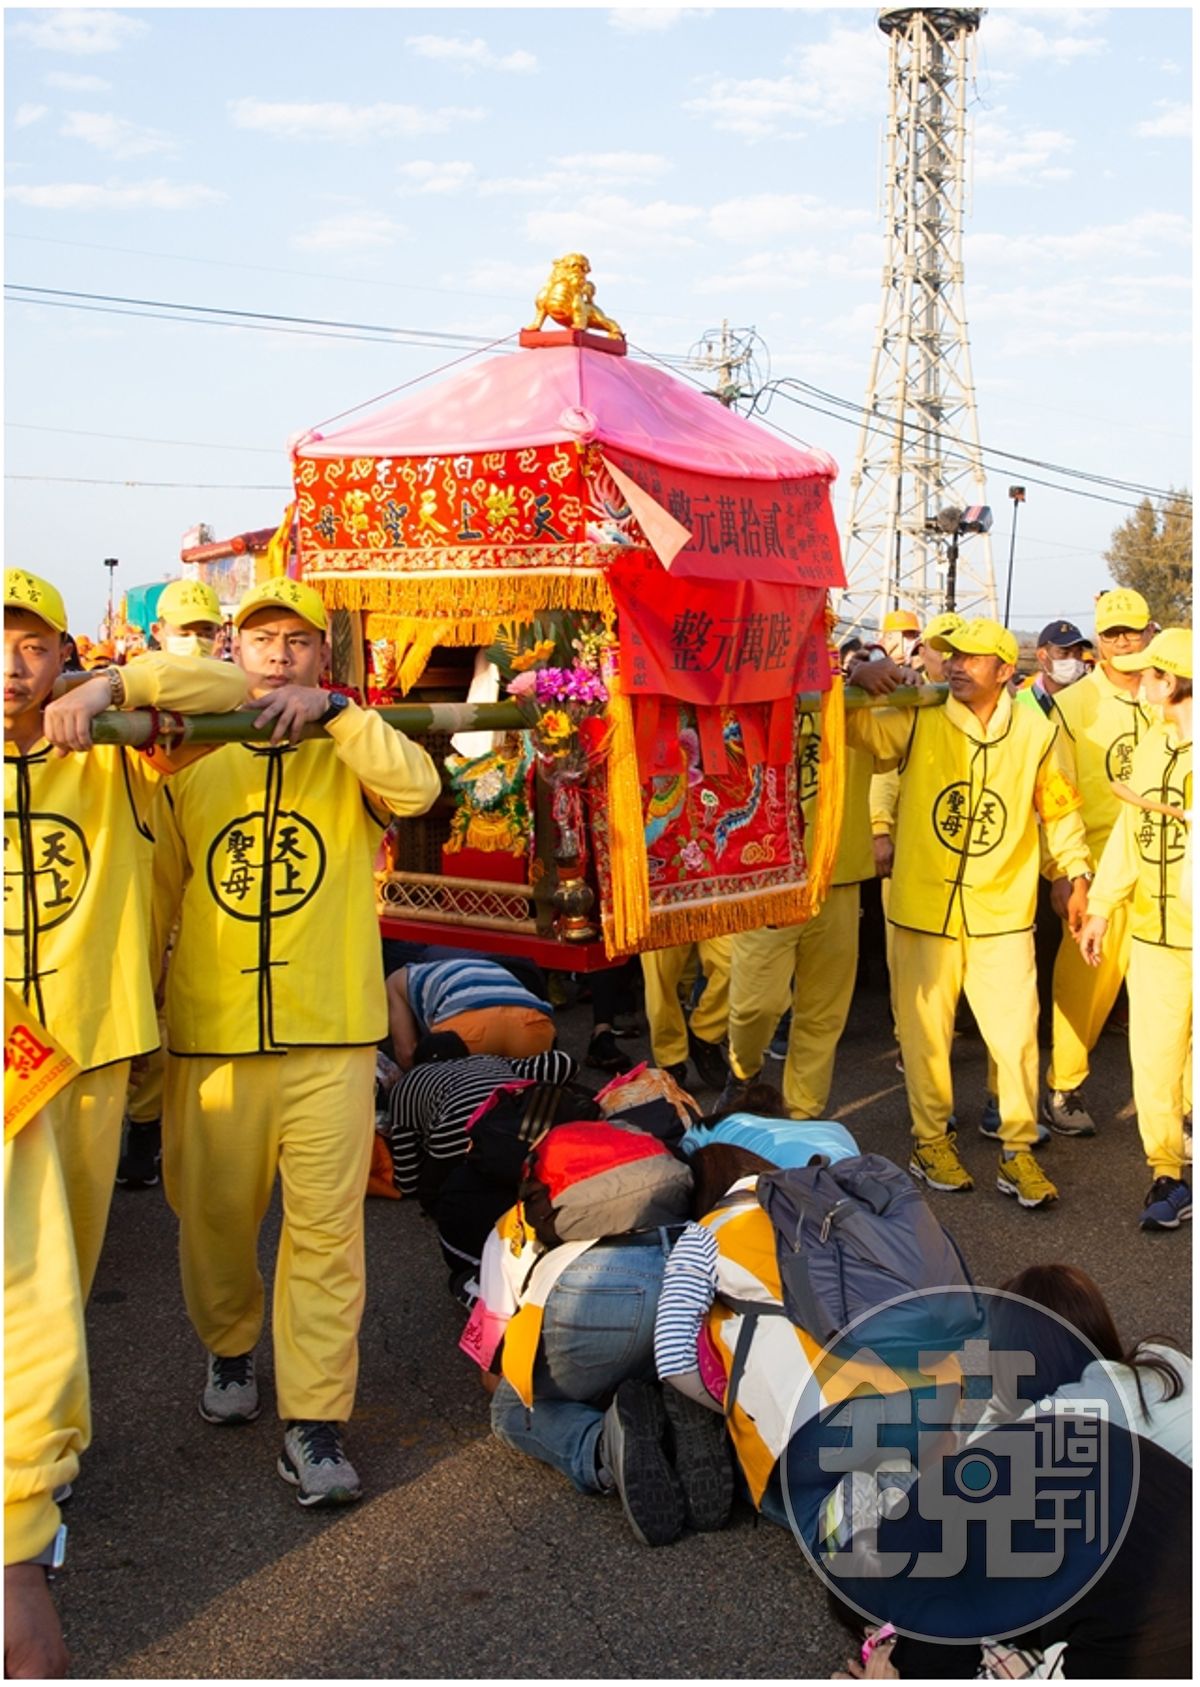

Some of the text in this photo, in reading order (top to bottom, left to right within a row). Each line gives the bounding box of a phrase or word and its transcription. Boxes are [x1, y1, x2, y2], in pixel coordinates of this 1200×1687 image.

[940, 790, 966, 837] 聖母
[972, 801, 996, 847] 天上
[38, 830, 77, 909] 天上
[220, 829, 255, 901] 聖母
[274, 826, 307, 897] 天上
